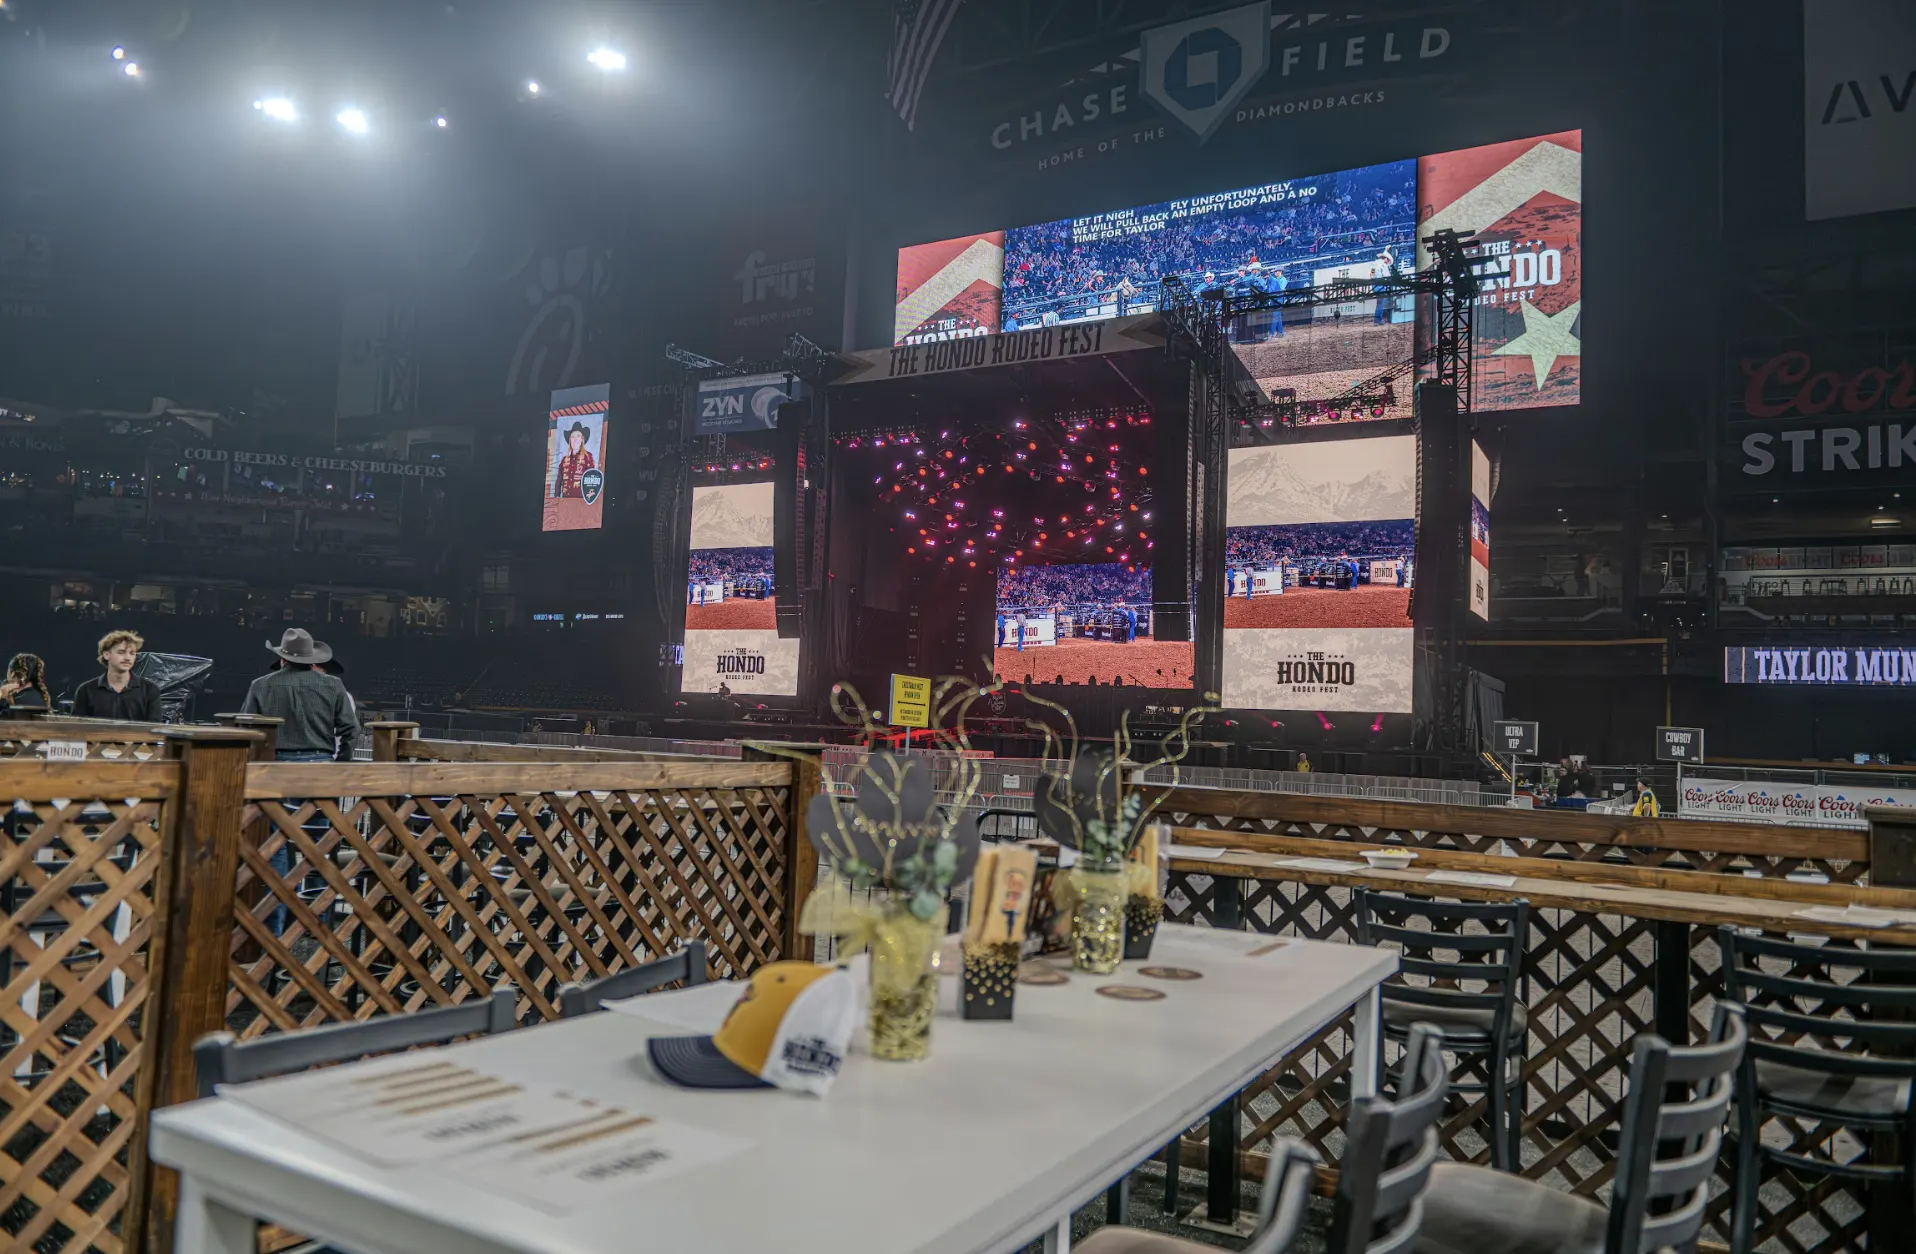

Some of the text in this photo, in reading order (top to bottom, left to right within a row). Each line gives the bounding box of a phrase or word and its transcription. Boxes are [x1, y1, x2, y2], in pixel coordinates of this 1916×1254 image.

[990, 27, 1452, 150] CHASE FIELD
[1038, 90, 1386, 170] HOME OF THE DIAMONDBACKS
[1073, 182, 1293, 228] LET IT NIGH FLY UNFORTUNATELY.
[1073, 186, 1317, 236] WE WILL PULL BACK AN EMPTY LOOP AND A NO
[1073, 221, 1165, 244] TIME FOR TAYLOR
[1482, 240, 1510, 256] THE
[1471, 249, 1561, 291] NDO
[1504, 289, 1535, 302] FEST
[938, 318, 956, 331] THE
[889, 346, 920, 377] THE
[924, 335, 987, 373] HONDO
[990, 326, 1053, 364] RODEO
[1058, 321, 1105, 357] FEST
[701, 394, 744, 418] ZYN
[1742, 424, 1916, 475] STRIK
[184, 448, 446, 478] COLD BEERS & CHEESEBURGERS
[1241, 578, 1266, 588] HNDO
[1012, 626, 1038, 638] HNDO
[1307, 651, 1324, 661] THE
[717, 655, 765, 674] HONDO
[1754, 650, 1916, 682] TAYLOR MUN
[1277, 661, 1355, 685] HONDO
[1505, 726, 1524, 737] ULTRA
[1665, 732, 1692, 744] COWBOY
[1508, 738, 1520, 749] VIP
[1671, 745, 1685, 756] BAR
[50, 746, 83, 758] HONDO
[1685, 788, 1714, 803] Coors
[1716, 790, 1745, 805] Coors
[1747, 791, 1780, 807] Coors
[1782, 794, 1816, 809] Coors
[1688, 801, 1710, 809] LIGHT
[1718, 803, 1742, 812] LIGHT
[1751, 806, 1776, 814] LIGHT
[1786, 808, 1812, 817] LIGHT
